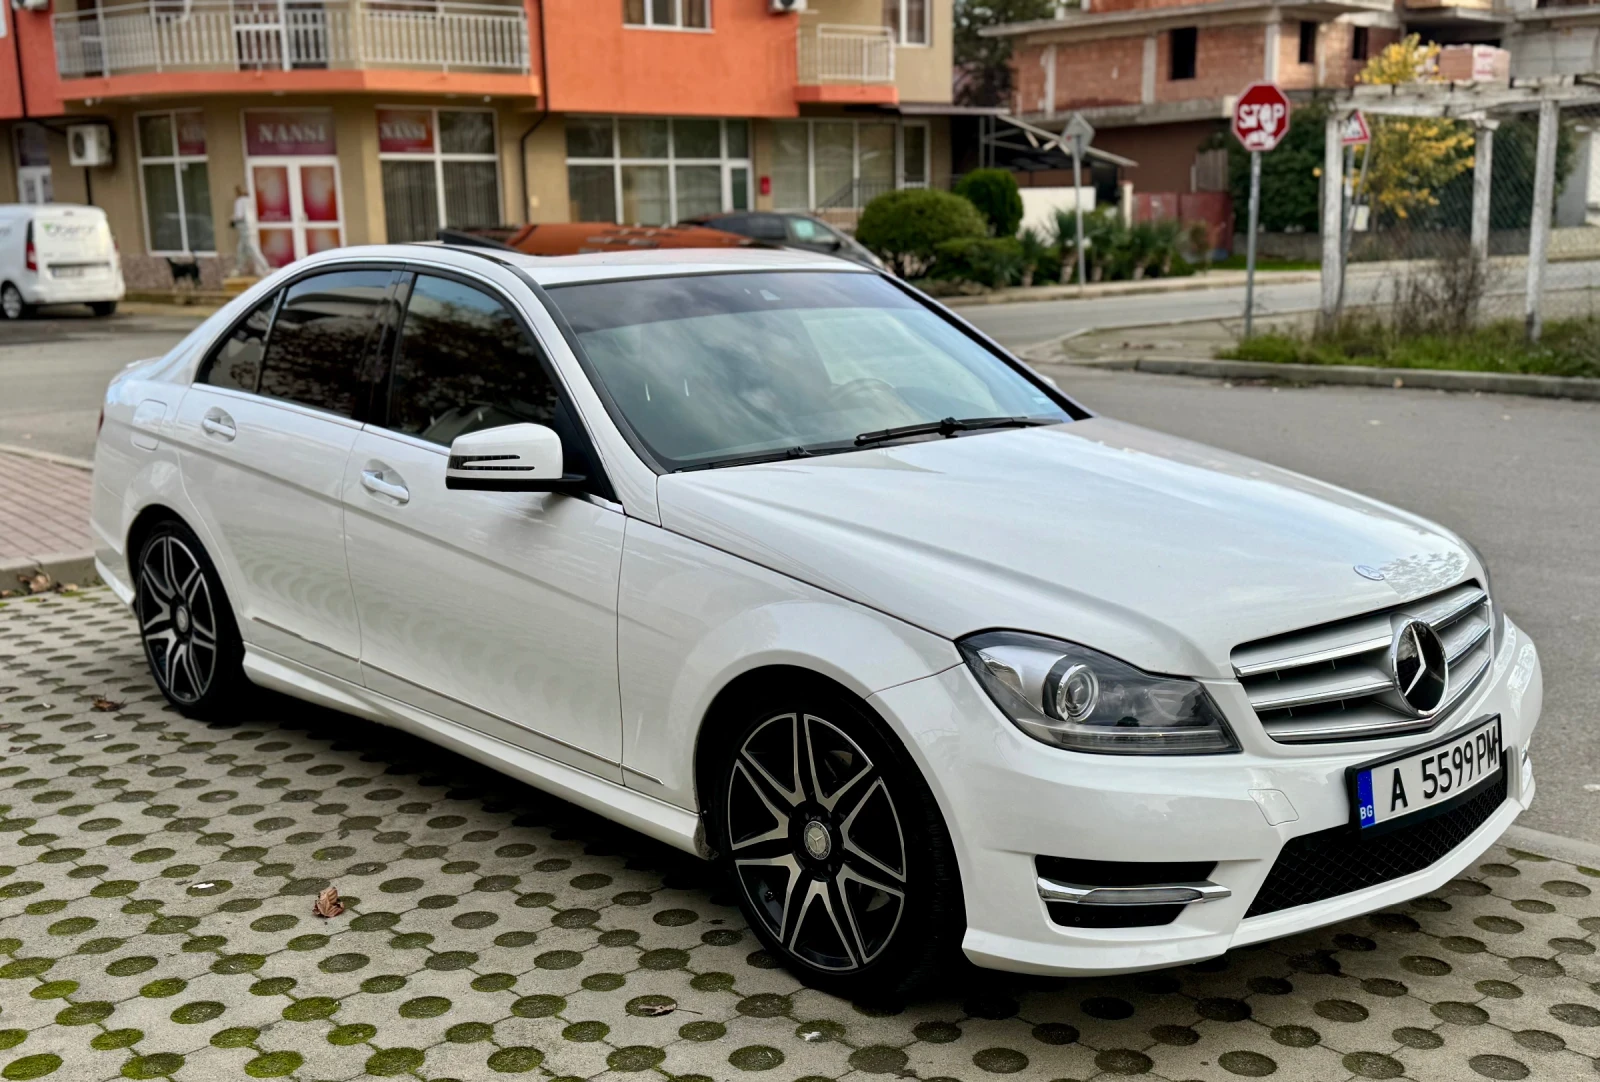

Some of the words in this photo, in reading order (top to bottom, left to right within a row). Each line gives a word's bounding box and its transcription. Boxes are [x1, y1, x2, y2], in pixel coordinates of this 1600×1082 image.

[1238, 103, 1285, 130] STOP
[259, 124, 326, 143] NANSI
[1390, 768, 1408, 812] A
[1421, 740, 1474, 799] 5599
[1360, 805, 1373, 819] BG
